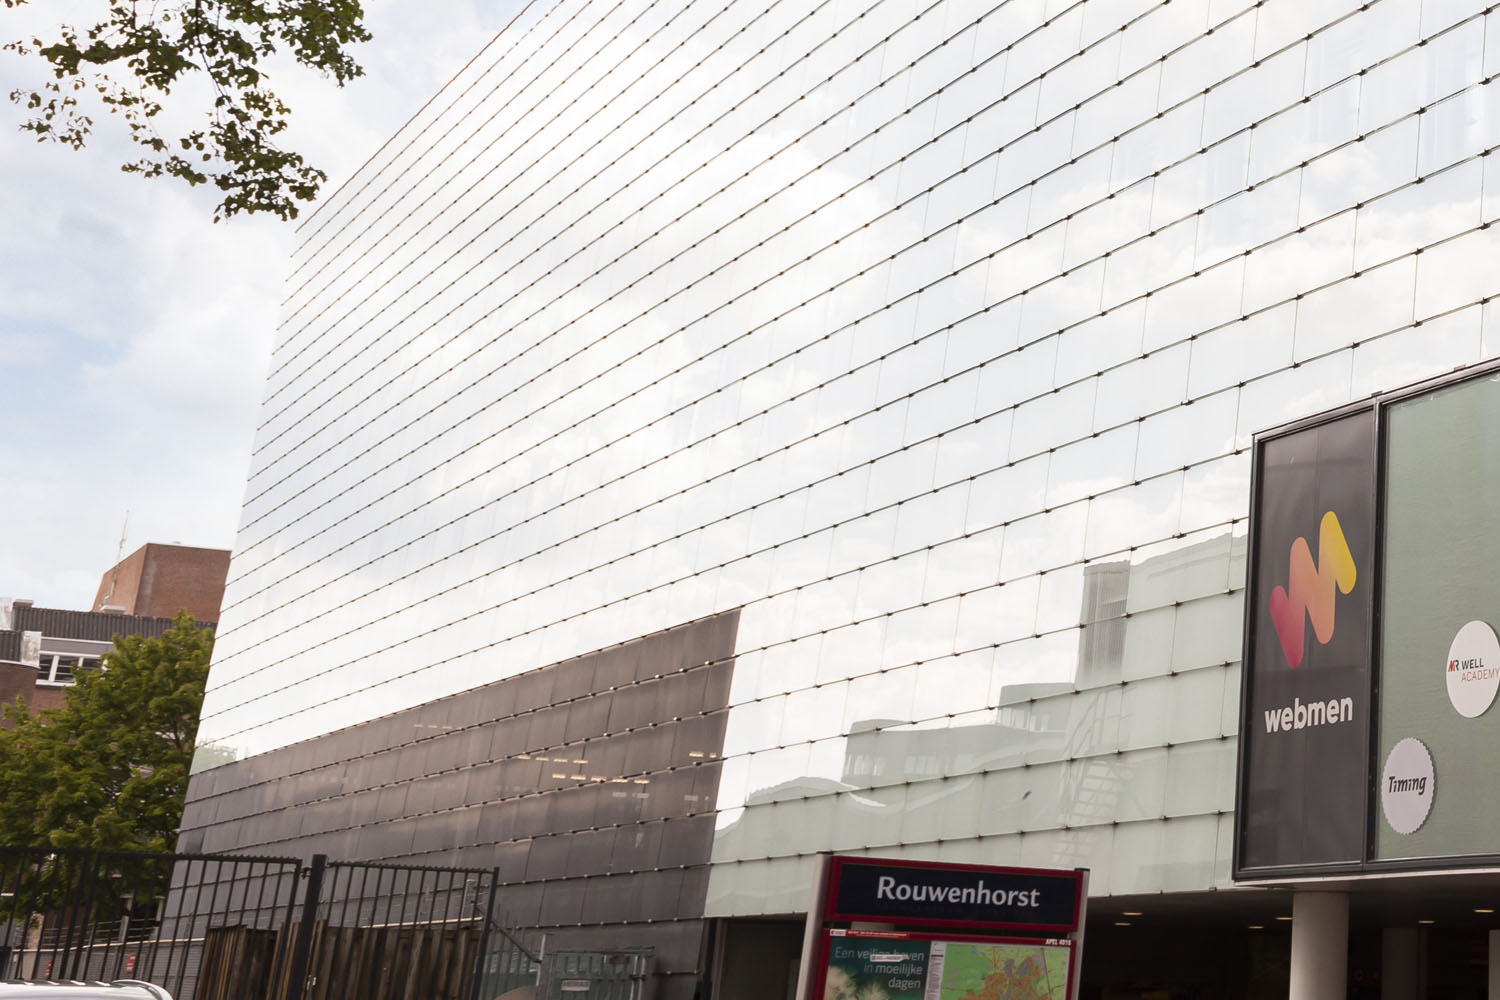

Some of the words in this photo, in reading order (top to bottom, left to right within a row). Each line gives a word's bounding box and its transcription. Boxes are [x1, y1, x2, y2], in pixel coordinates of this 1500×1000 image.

[1461, 658, 1484, 670] WELL
[1461, 667, 1500, 682] ACADEMY
[1264, 696, 1353, 733] webmen
[1388, 774, 1428, 796] Timing
[876, 875, 1040, 907] Rouwenhorst
[834, 946, 855, 958] Een
[863, 963, 874, 973] in
[875, 963, 923, 976] moeilijke
[888, 977, 921, 990] dagen
